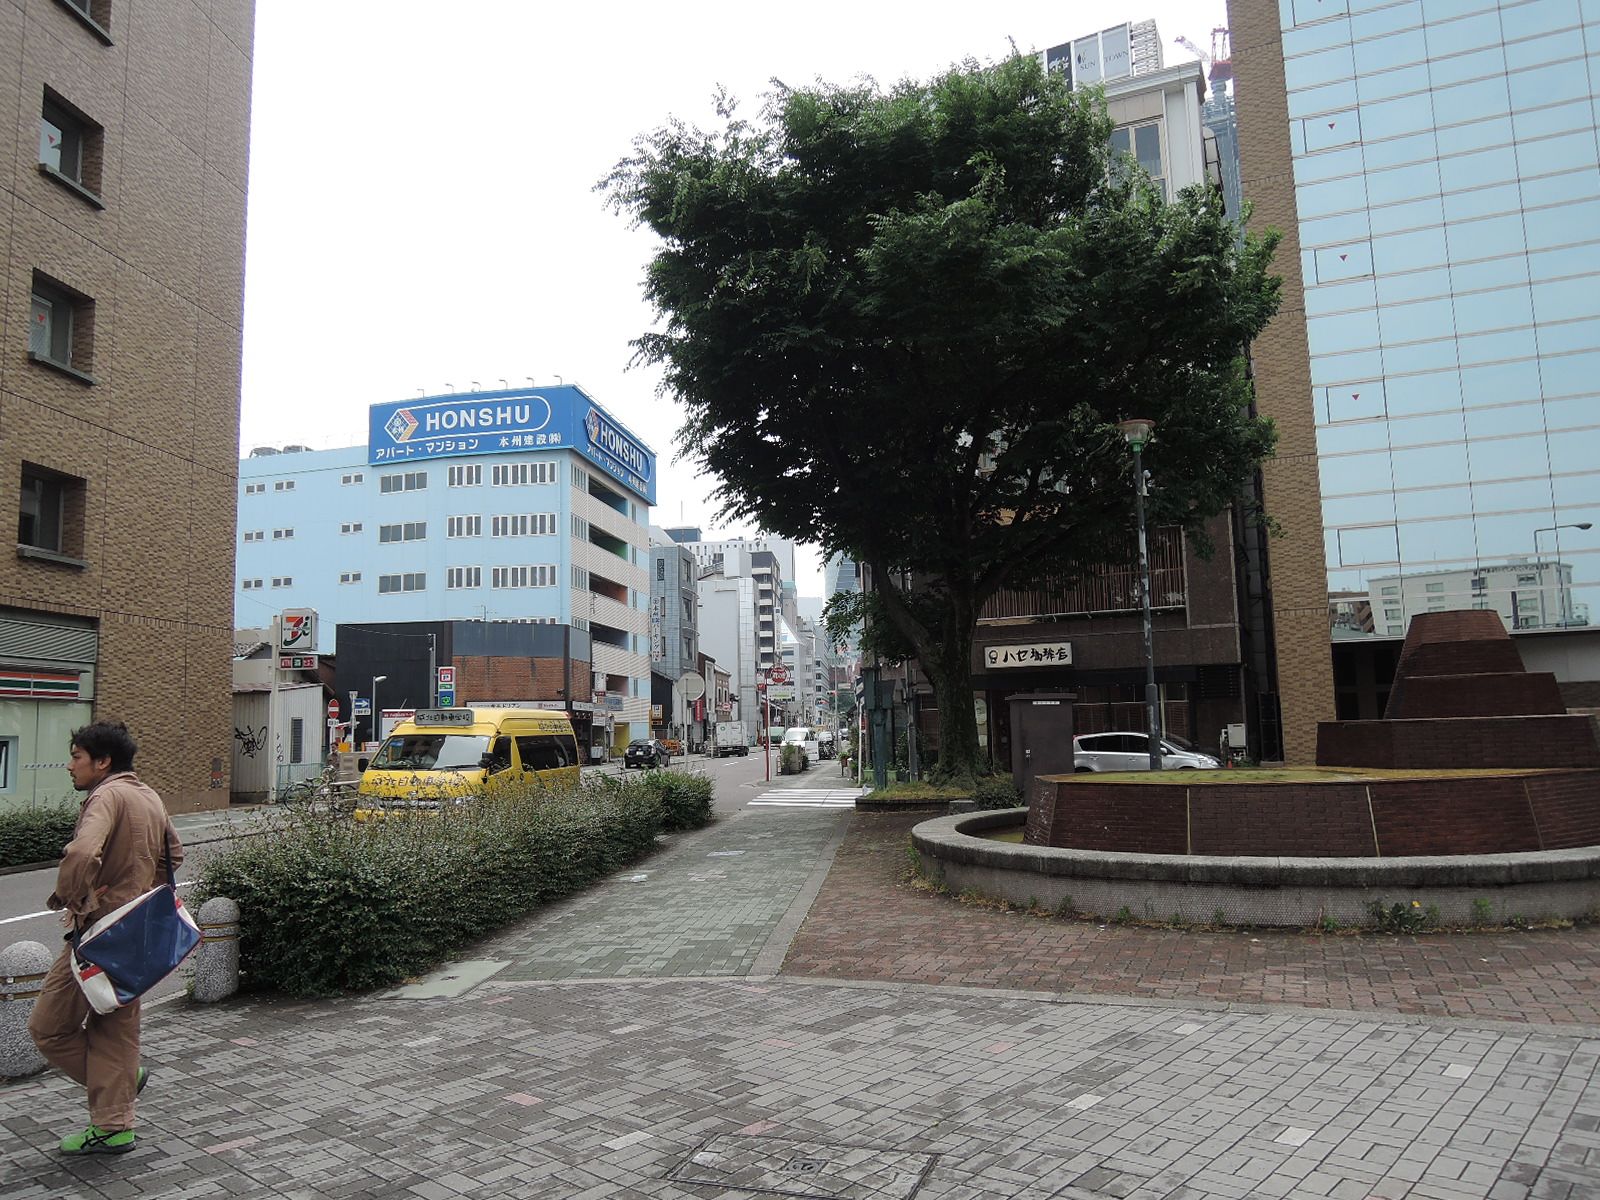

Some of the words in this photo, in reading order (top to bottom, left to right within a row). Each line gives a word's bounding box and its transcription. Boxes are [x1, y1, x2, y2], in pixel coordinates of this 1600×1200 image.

[1104, 50, 1128, 63] TOWN
[425, 405, 530, 432] HONSHU
[375, 439, 479, 460] アパート・マンション
[600, 423, 643, 472] HONSHU
[1002, 646, 1068, 663] ハセ珈琲店
